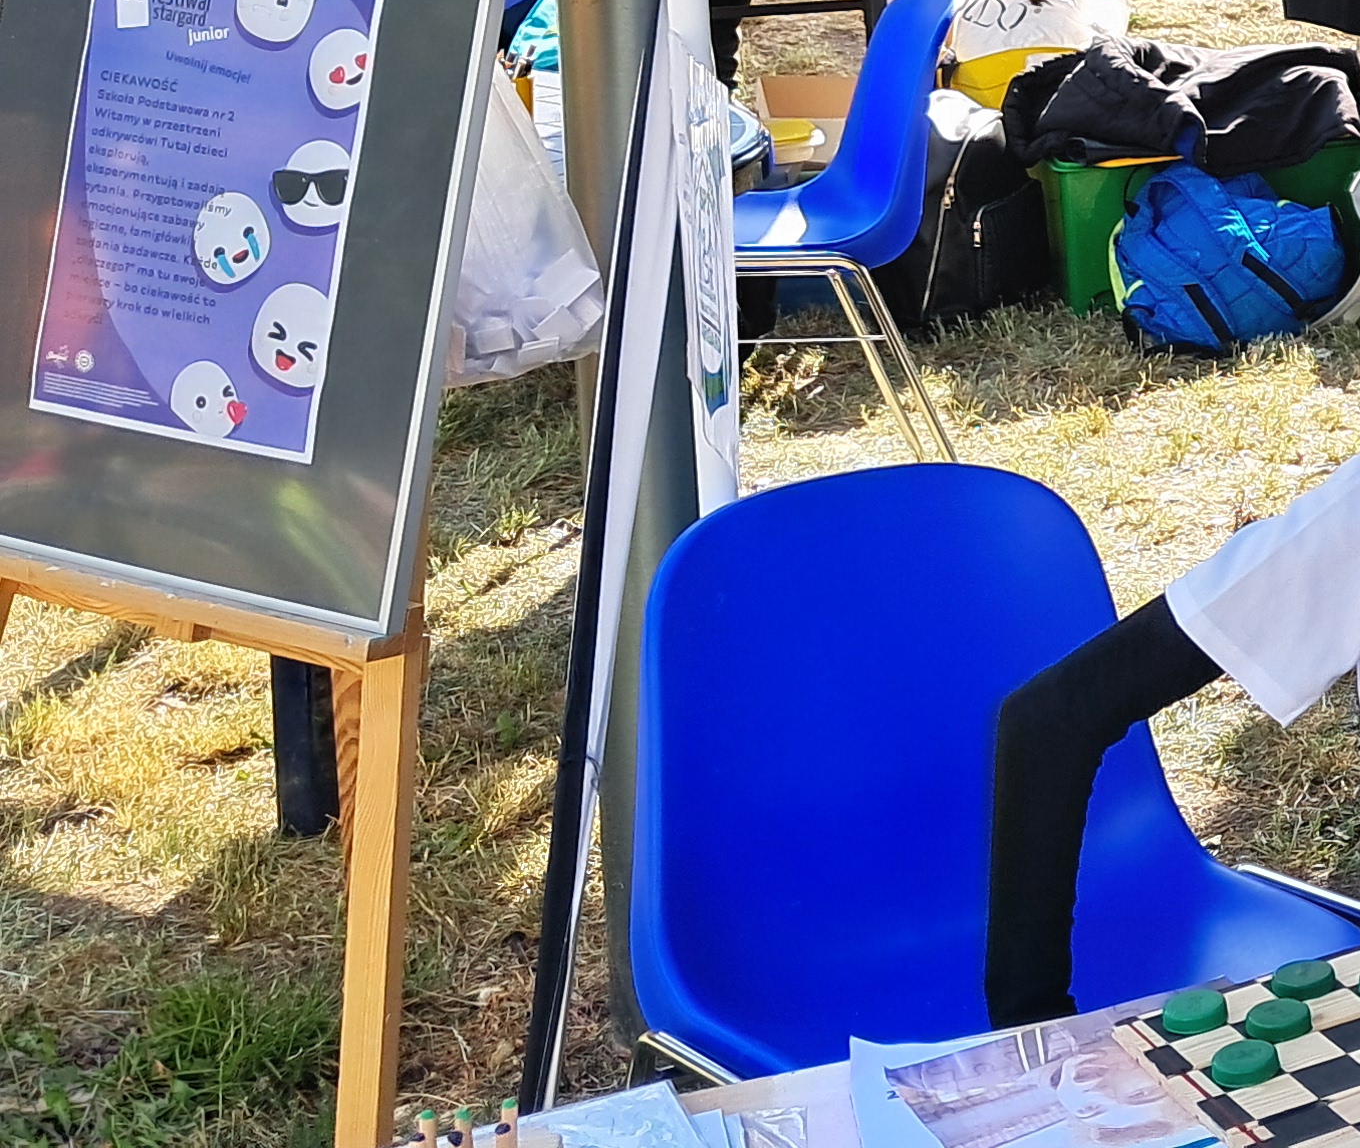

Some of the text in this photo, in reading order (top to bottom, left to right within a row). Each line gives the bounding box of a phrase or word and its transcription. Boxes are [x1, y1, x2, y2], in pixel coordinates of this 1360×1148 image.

[153, 5, 207, 27] stargard
[188, 26, 229, 46] junior
[166, 51, 207, 72] Uwolnij
[101, 70, 178, 92] CIEKAWOŚĆ
[98, 89, 235, 121] Szkoła Podstawowa nr 2
[95, 107, 221, 138] Witamy w przestrzeni
[161, 137, 191, 154] Tutaj
[193, 143, 228, 158] dzieci
[86, 164, 177, 189] eksperymentują
[188, 181, 225, 198] zadają
[133, 189, 231, 216] Przygotowaliśmy
[162, 215, 204, 231] zabawy
[137, 266, 154, 277] ma
[158, 270, 170, 280] tu
[124, 282, 138, 293] bo
[141, 287, 200, 304] ciekawość
[202, 296, 216, 307] to
[117, 299, 141, 312] krok
[144, 304, 158, 315] do
[162, 308, 211, 324] wielkich
